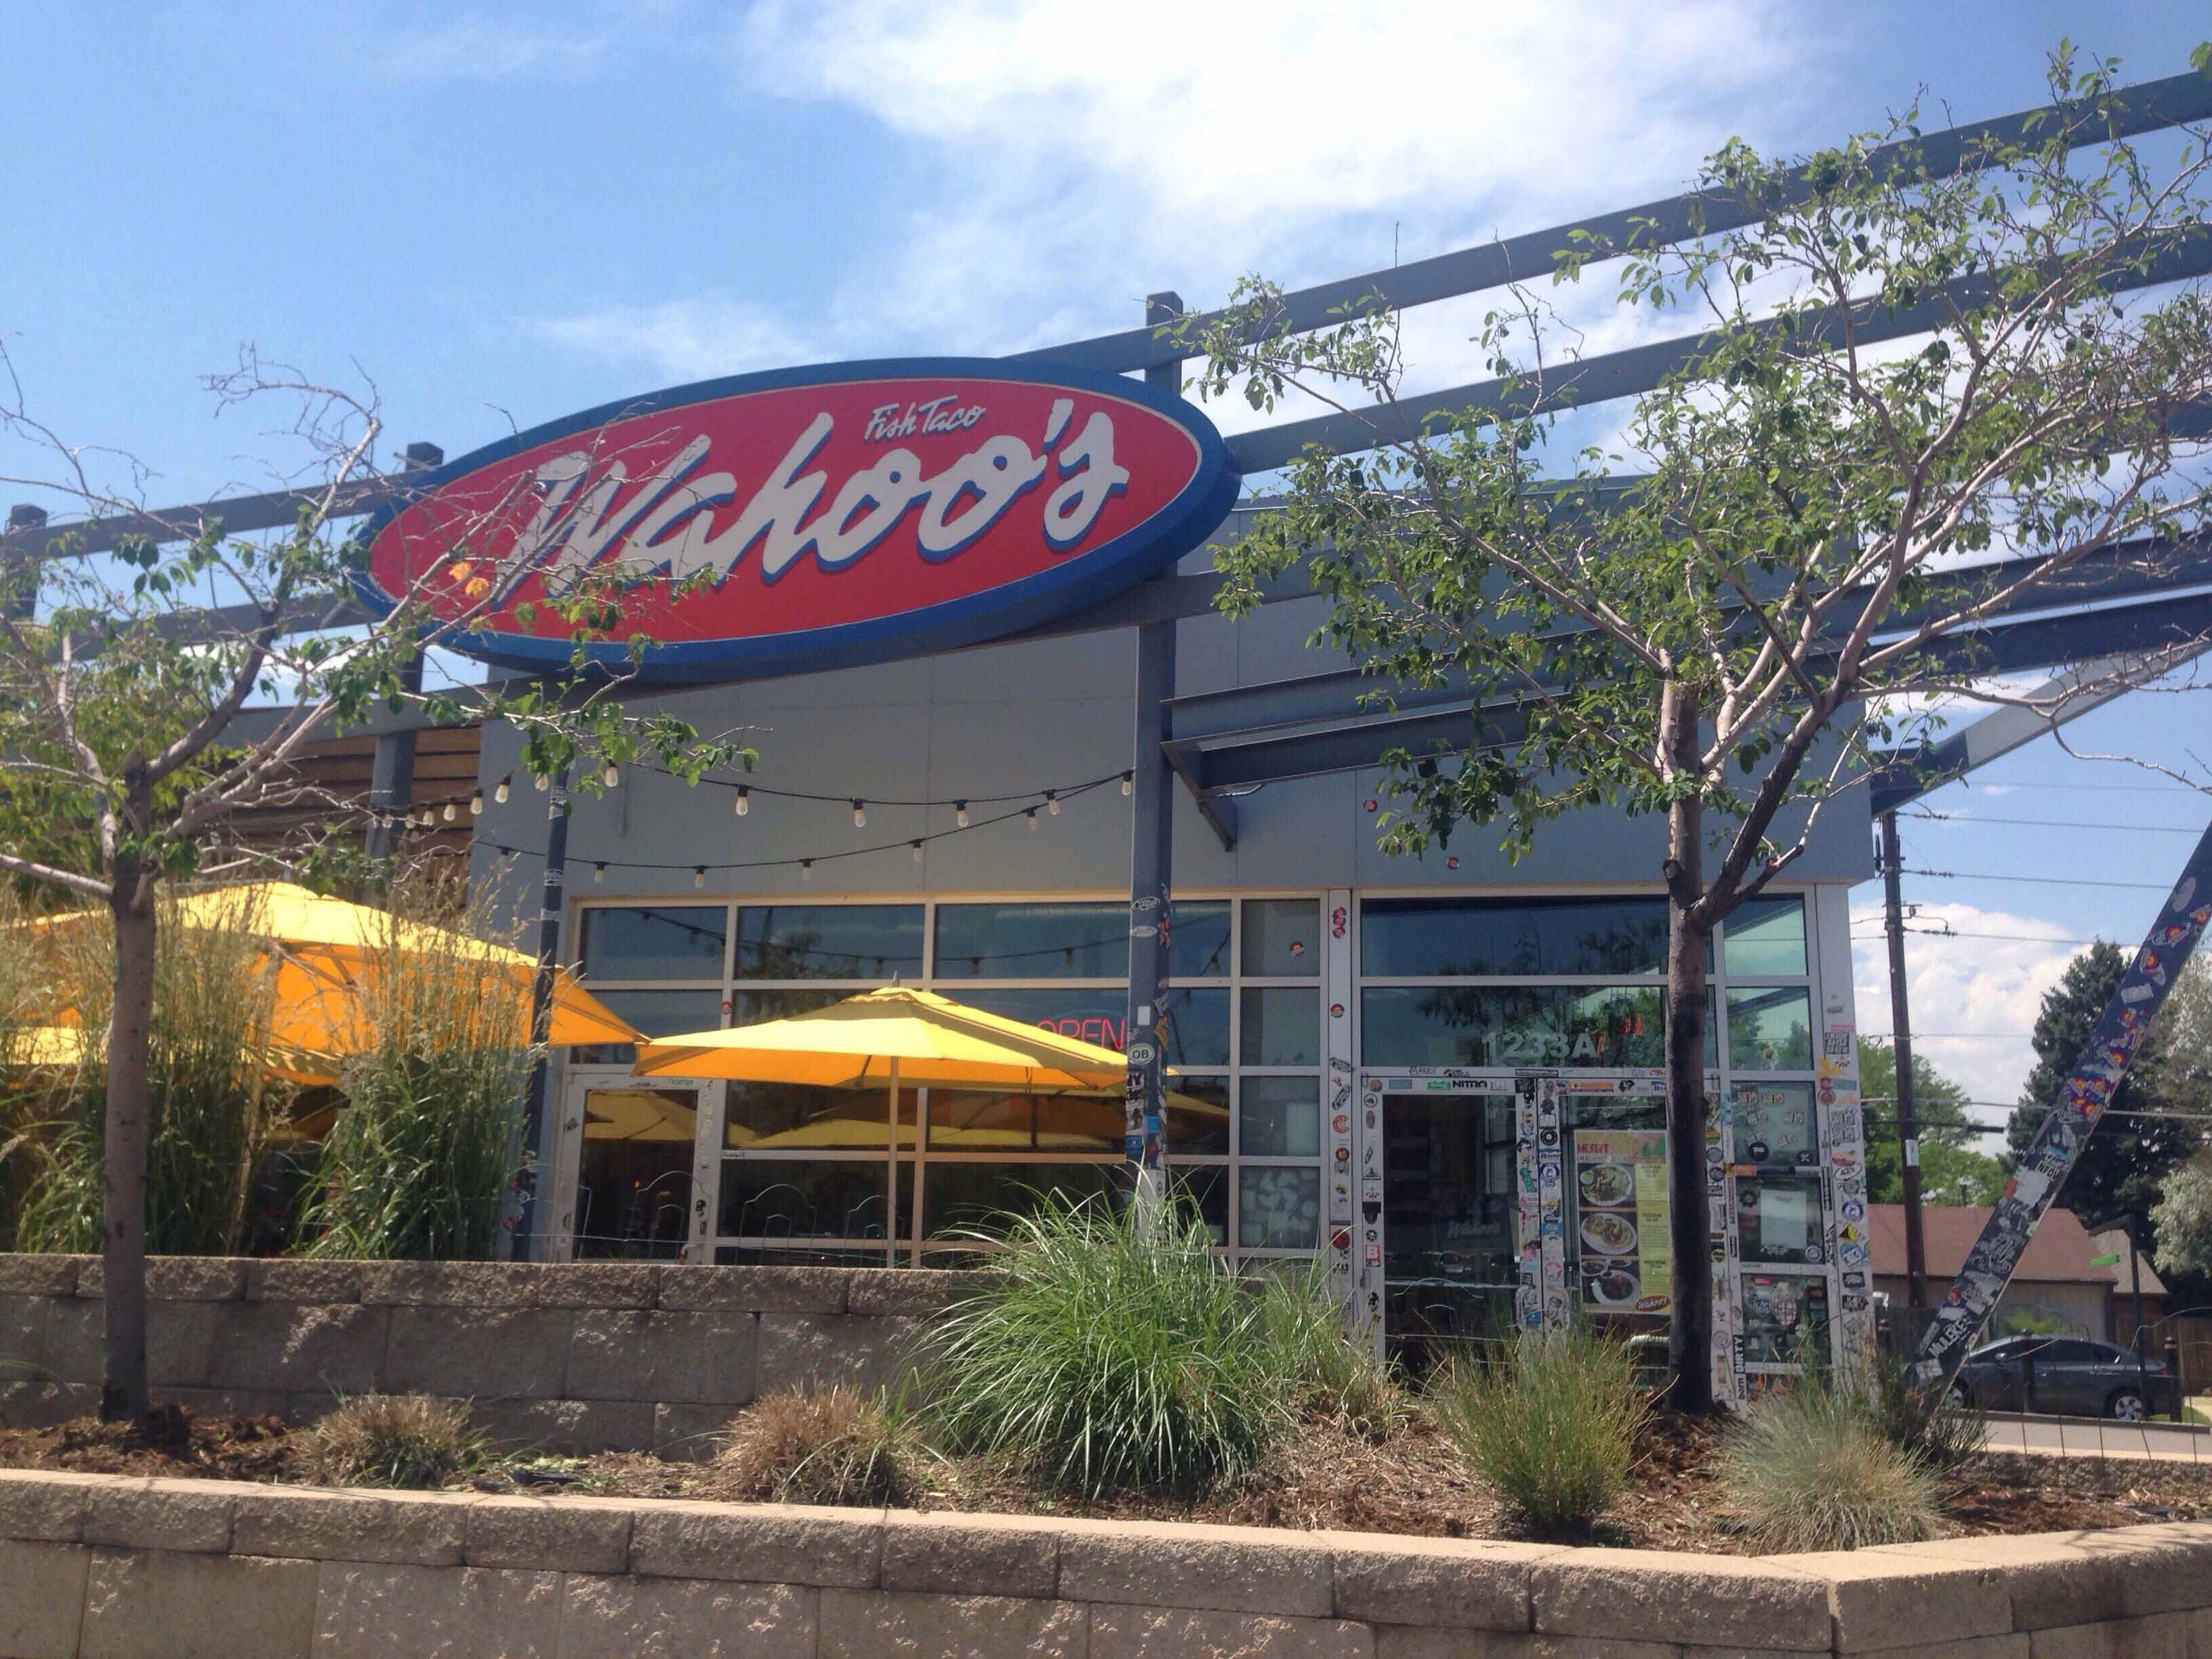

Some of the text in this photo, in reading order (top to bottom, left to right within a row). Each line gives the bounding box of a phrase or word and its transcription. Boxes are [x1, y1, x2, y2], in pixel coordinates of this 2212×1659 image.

[864, 394, 986, 442] Fish Taco
[491, 397, 1130, 599] Wahoo's
[1132, 1050, 1149, 1059] OB
[1734, 1336, 1744, 1374] DIRTY
